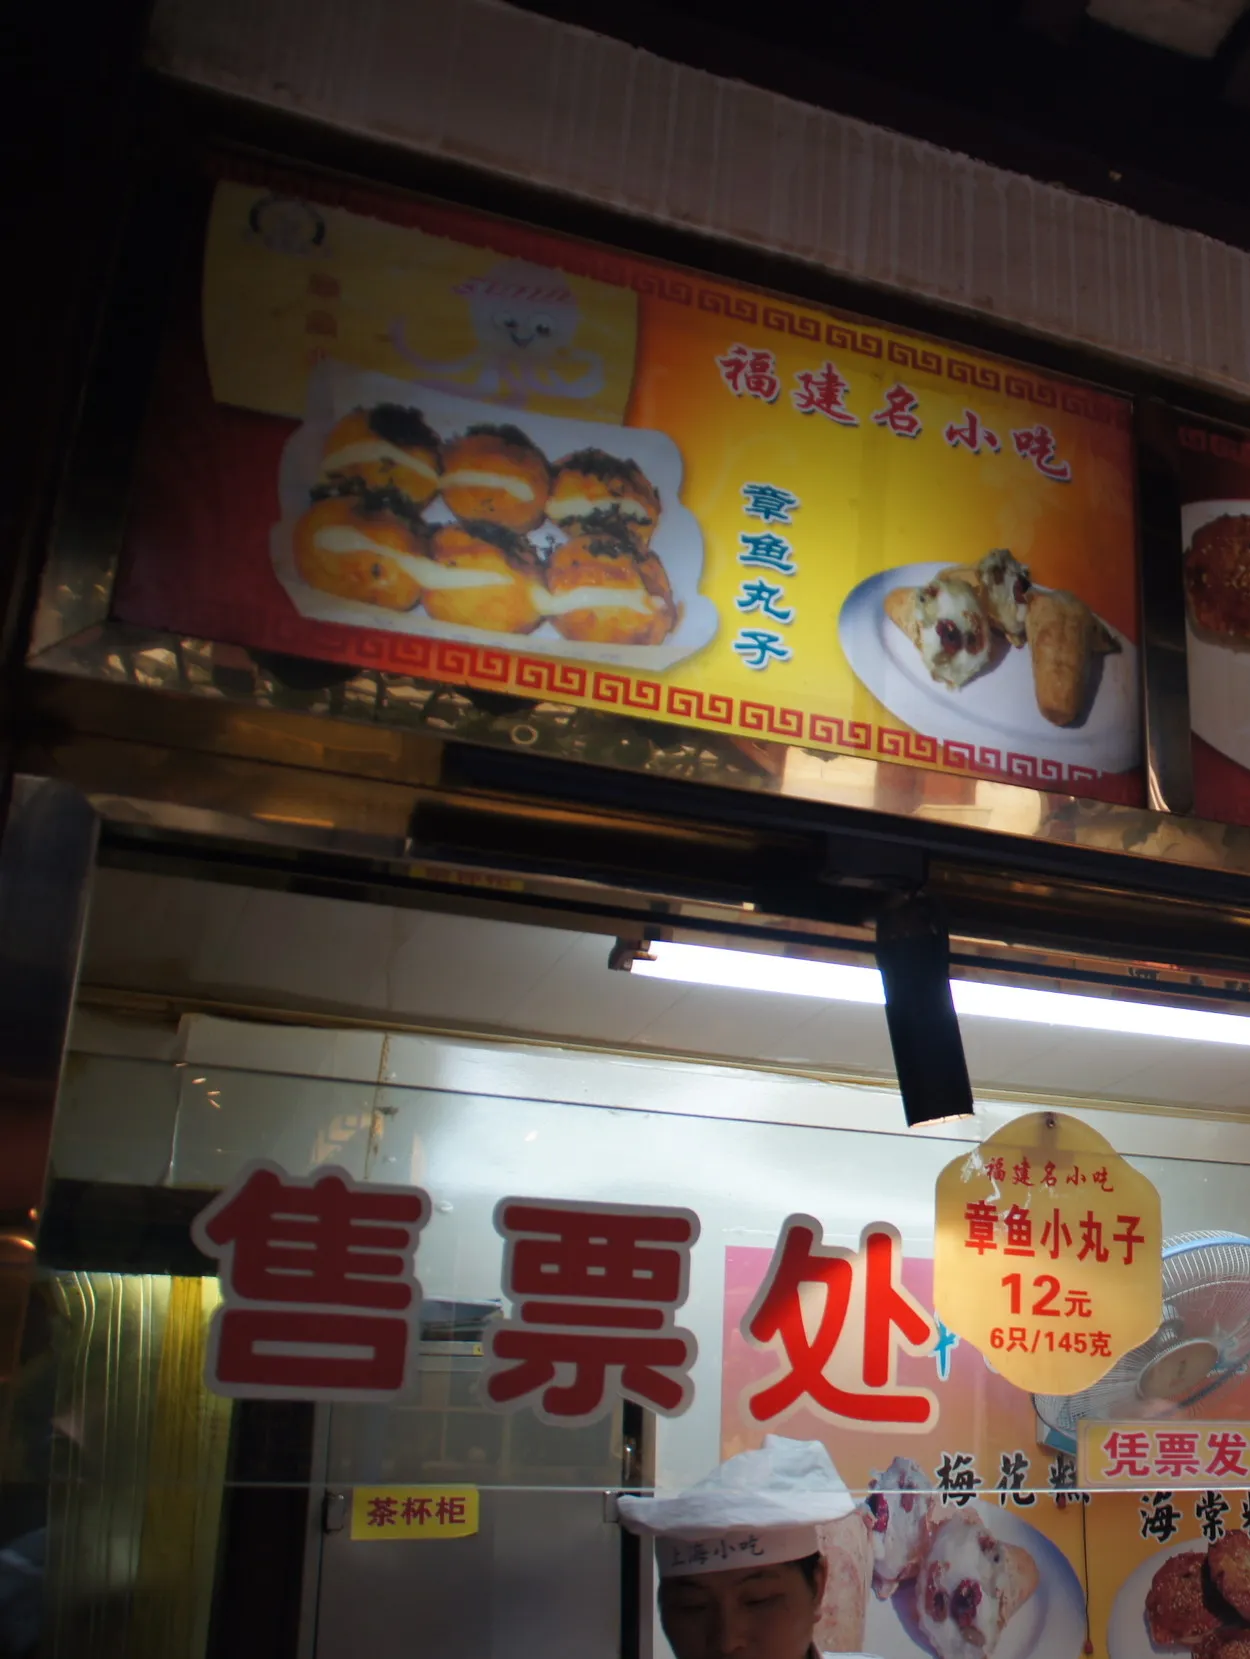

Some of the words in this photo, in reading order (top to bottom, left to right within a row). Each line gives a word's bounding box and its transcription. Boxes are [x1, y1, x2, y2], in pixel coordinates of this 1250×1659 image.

[718, 344, 1072, 480] 福建名小吃
[734, 483, 798, 668] 章鱼丸子
[985, 1156, 1114, 1193] 福建名小吃
[964, 1200, 1145, 1265] 章鱼小丸子
[203, 1168, 931, 1423] 售票处
[1000, 1273, 1092, 1318] 12元
[990, 1327, 1112, 1357] 6只/145克
[366, 1496, 467, 1527] 茶杯柜
[670, 1534, 764, 1567] 上海小吃
